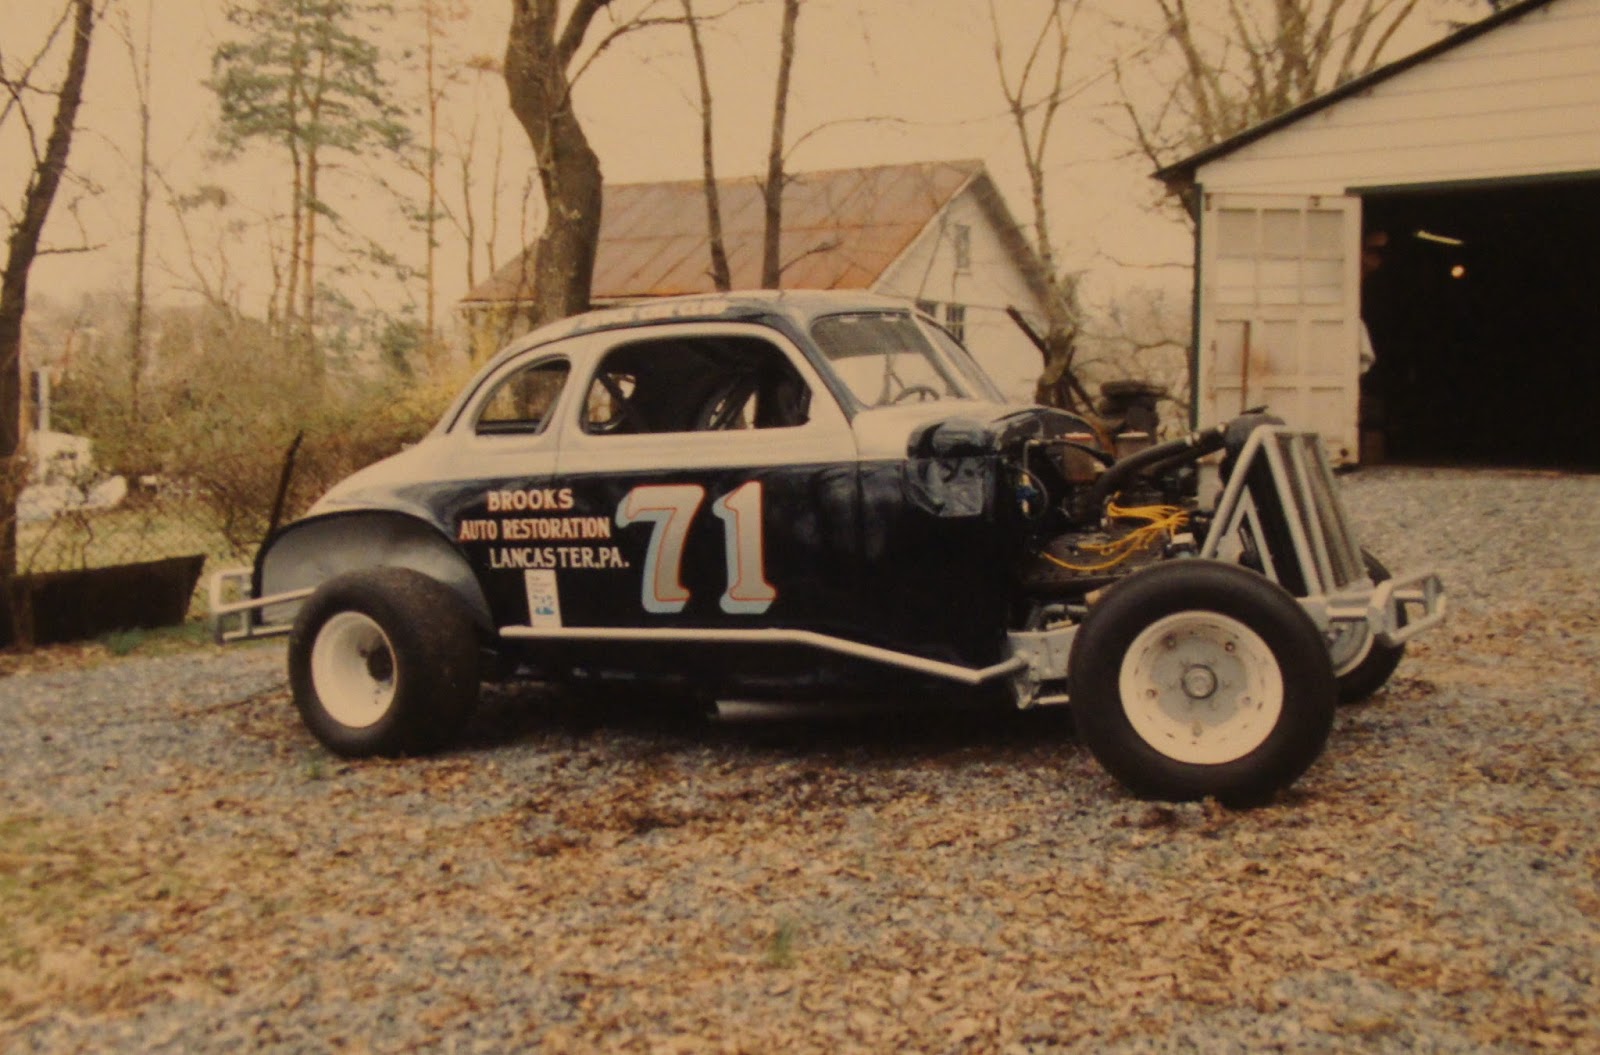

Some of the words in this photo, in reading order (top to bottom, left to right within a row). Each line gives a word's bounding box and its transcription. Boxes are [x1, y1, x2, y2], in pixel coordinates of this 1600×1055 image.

[487, 488, 574, 511] BROOKS
[459, 520, 498, 541] AUTO
[502, 517, 611, 540] RESTORATION
[615, 480, 778, 614] 71
